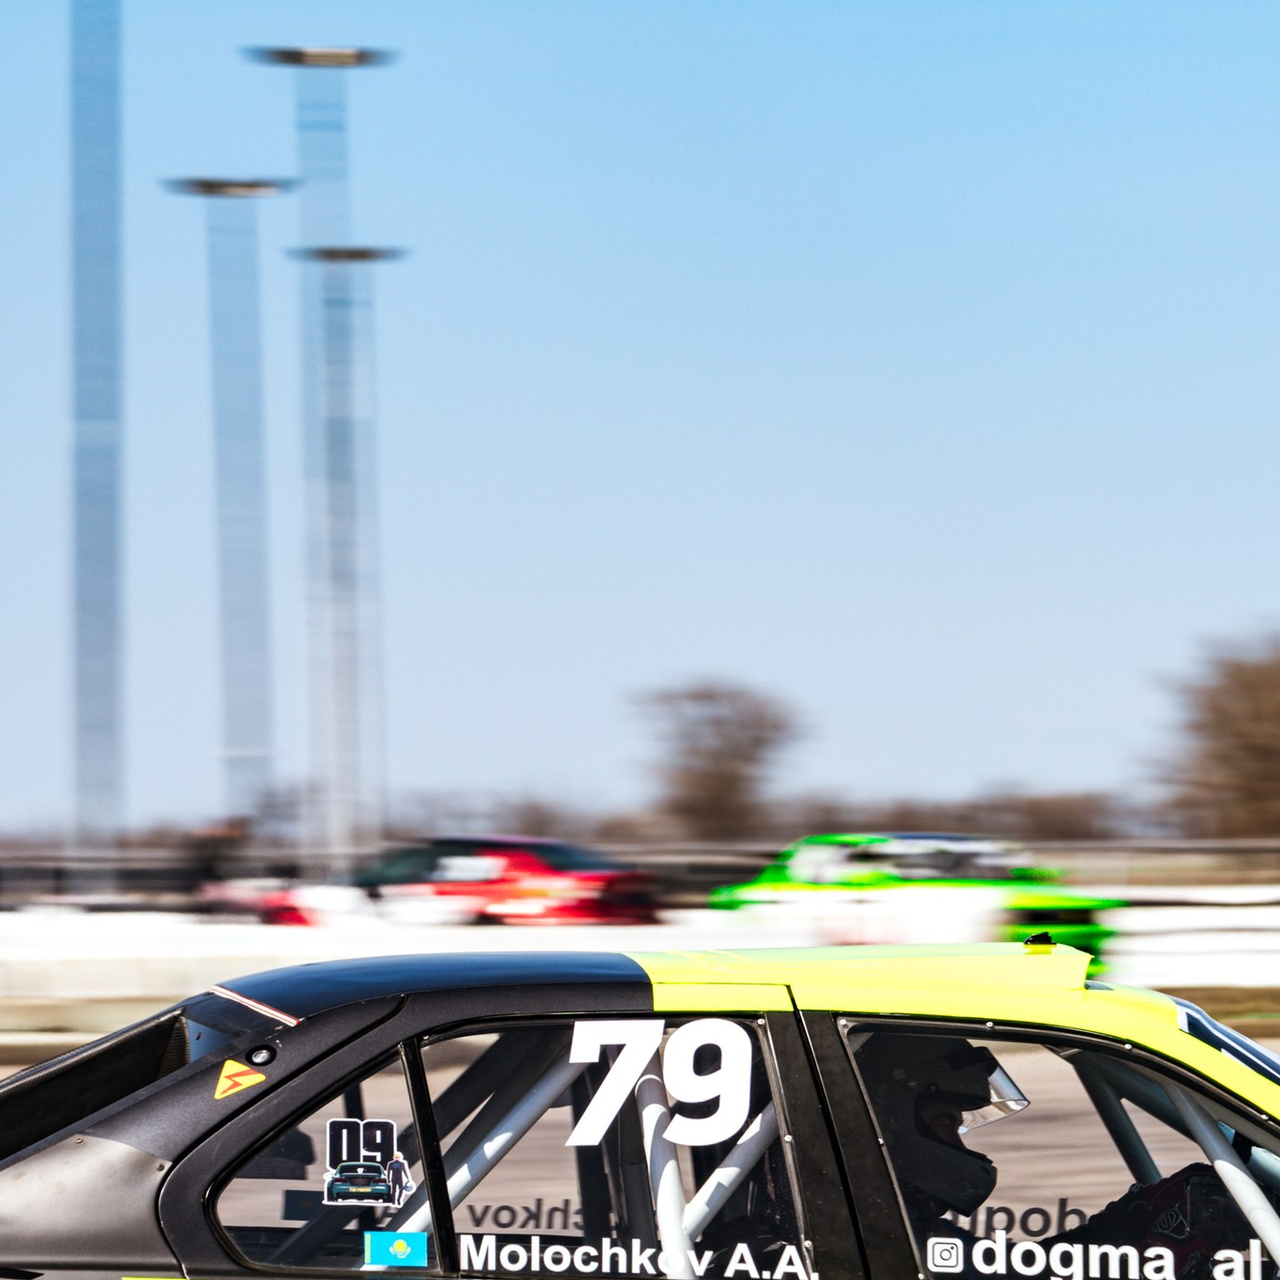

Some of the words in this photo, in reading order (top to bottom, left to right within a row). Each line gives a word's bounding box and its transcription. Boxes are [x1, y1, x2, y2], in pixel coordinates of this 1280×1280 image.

[565, 1018, 753, 1146] 79
[328, 1120, 396, 1171] 09
[460, 1234, 713, 1276] Molochkov
[723, 1243, 820, 1280] A.A.
